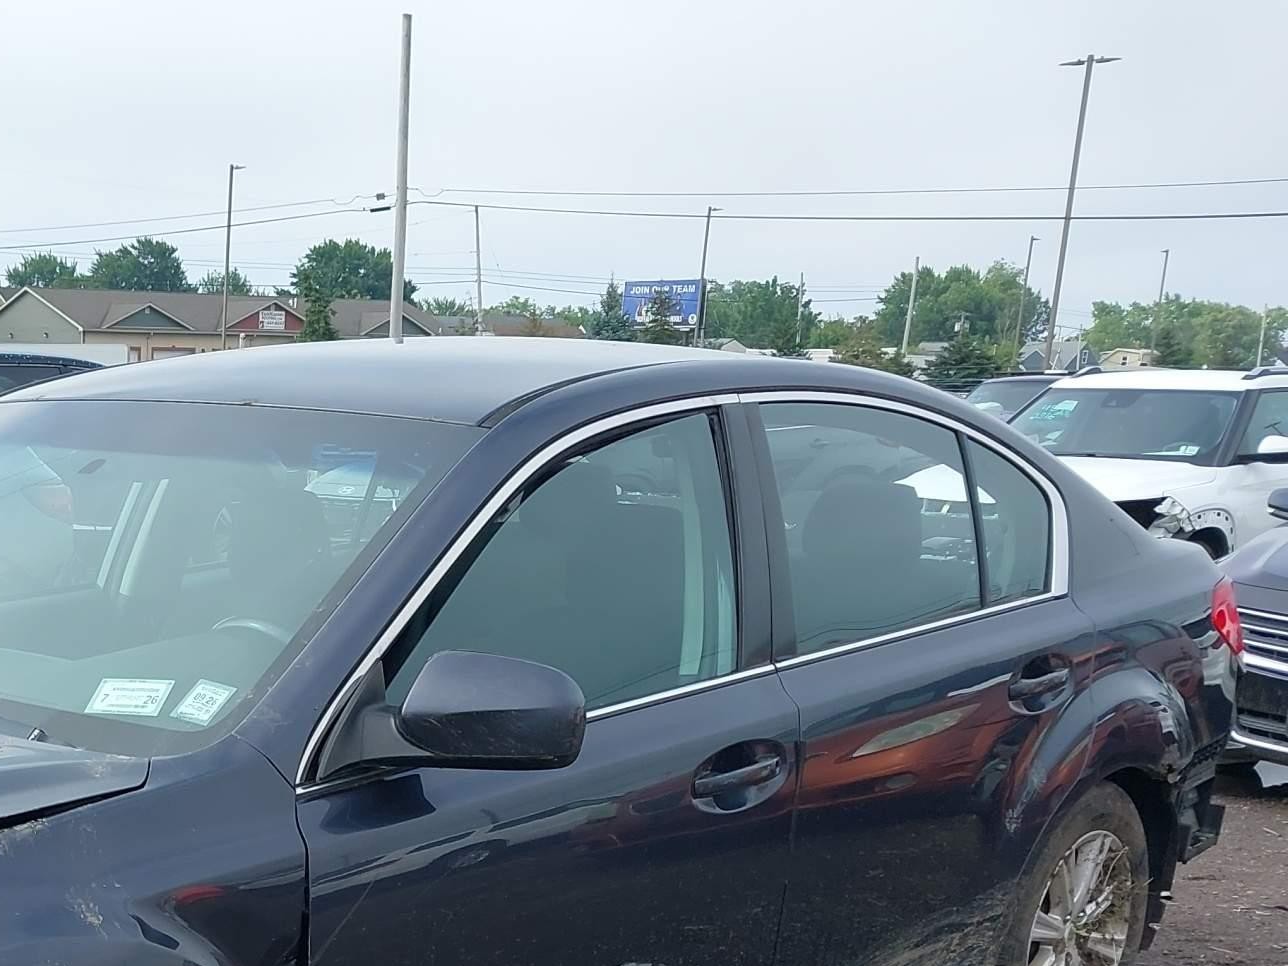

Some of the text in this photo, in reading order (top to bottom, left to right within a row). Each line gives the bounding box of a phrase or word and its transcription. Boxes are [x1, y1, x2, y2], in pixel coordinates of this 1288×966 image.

[630, 285, 650, 294] JOIN
[672, 284, 696, 293] TEAM
[143, 695, 160, 705] 26
